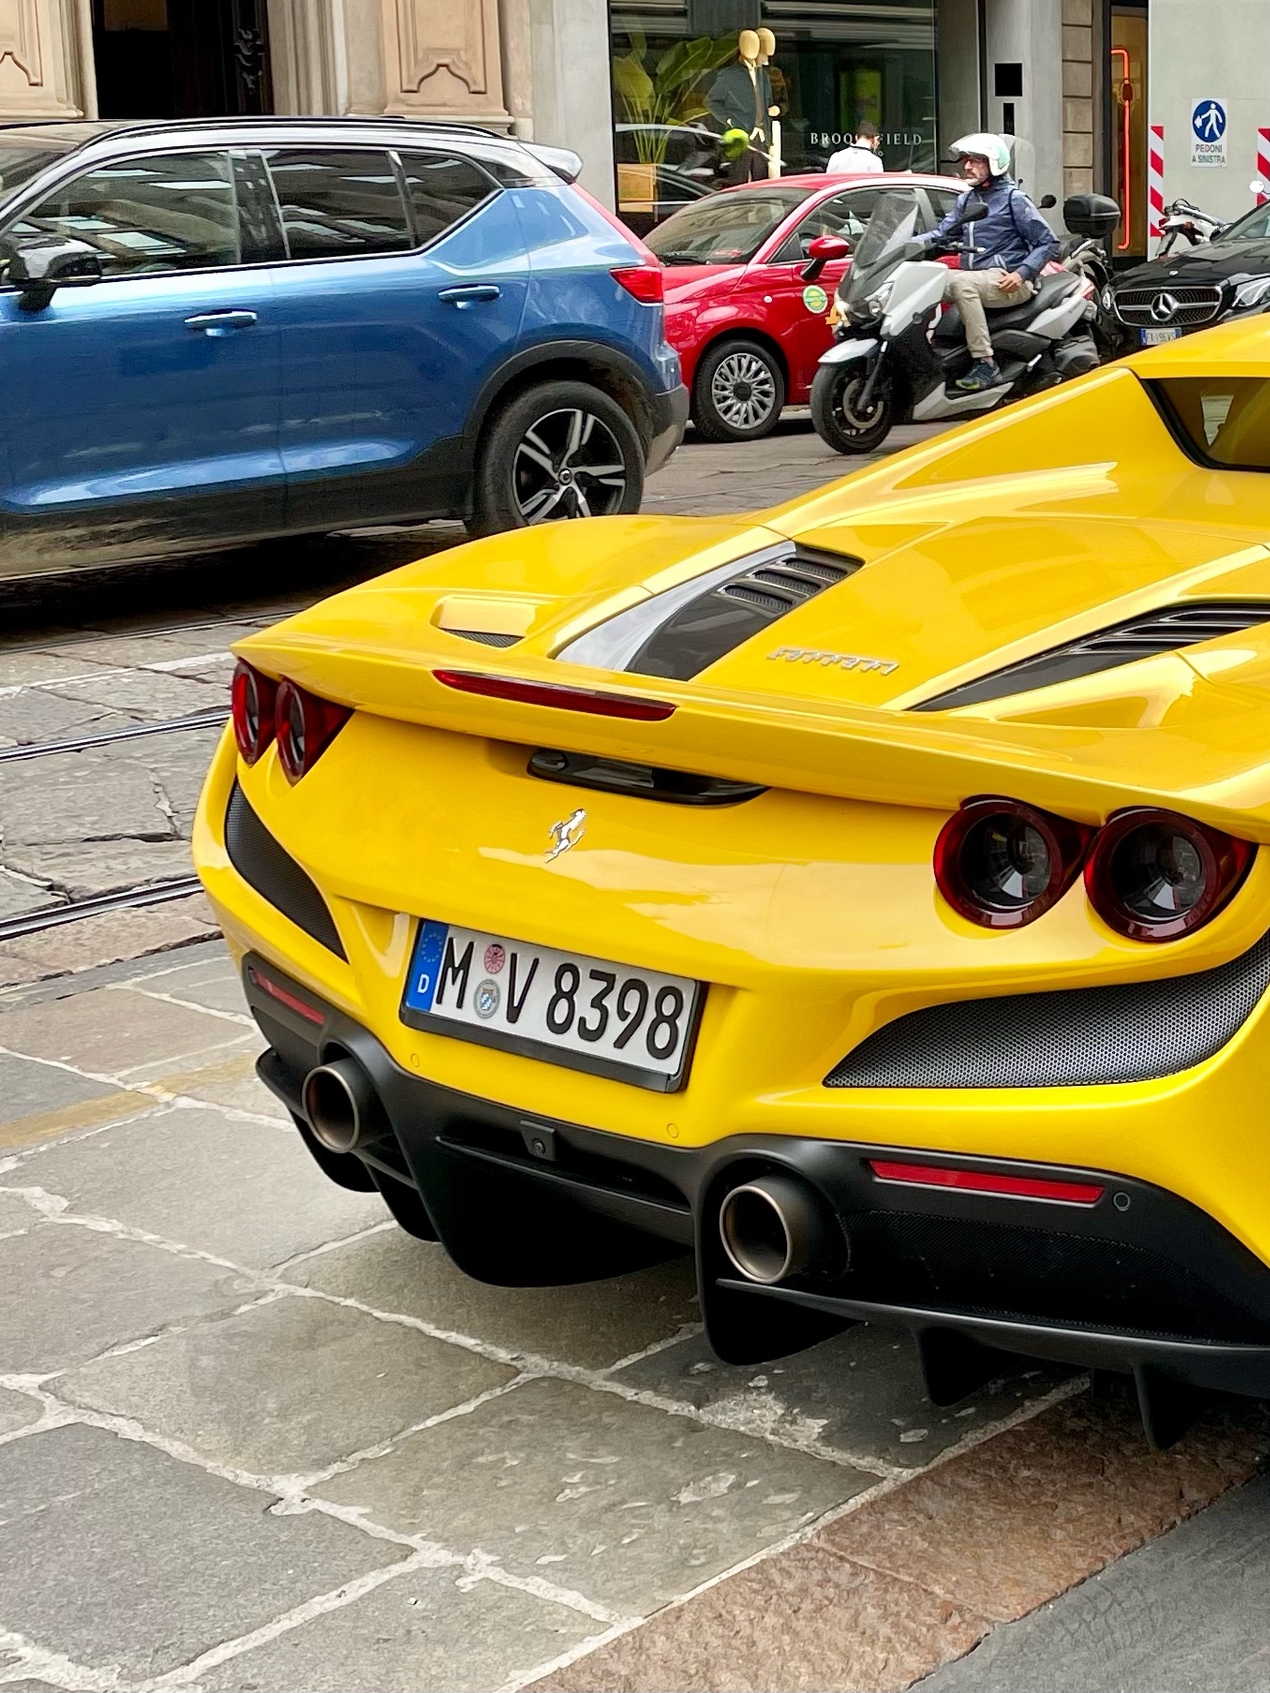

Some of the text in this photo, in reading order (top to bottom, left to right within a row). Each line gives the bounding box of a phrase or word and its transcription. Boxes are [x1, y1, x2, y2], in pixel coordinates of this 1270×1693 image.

[810, 132, 922, 146] BROOIELD
[1195, 144, 1223, 153] PEDONI
[1192, 155, 1226, 163] A SINISTRA
[766, 648, 900, 676] Ferrari
[417, 973, 430, 994] D
[435, 937, 684, 1060] M V 8398
